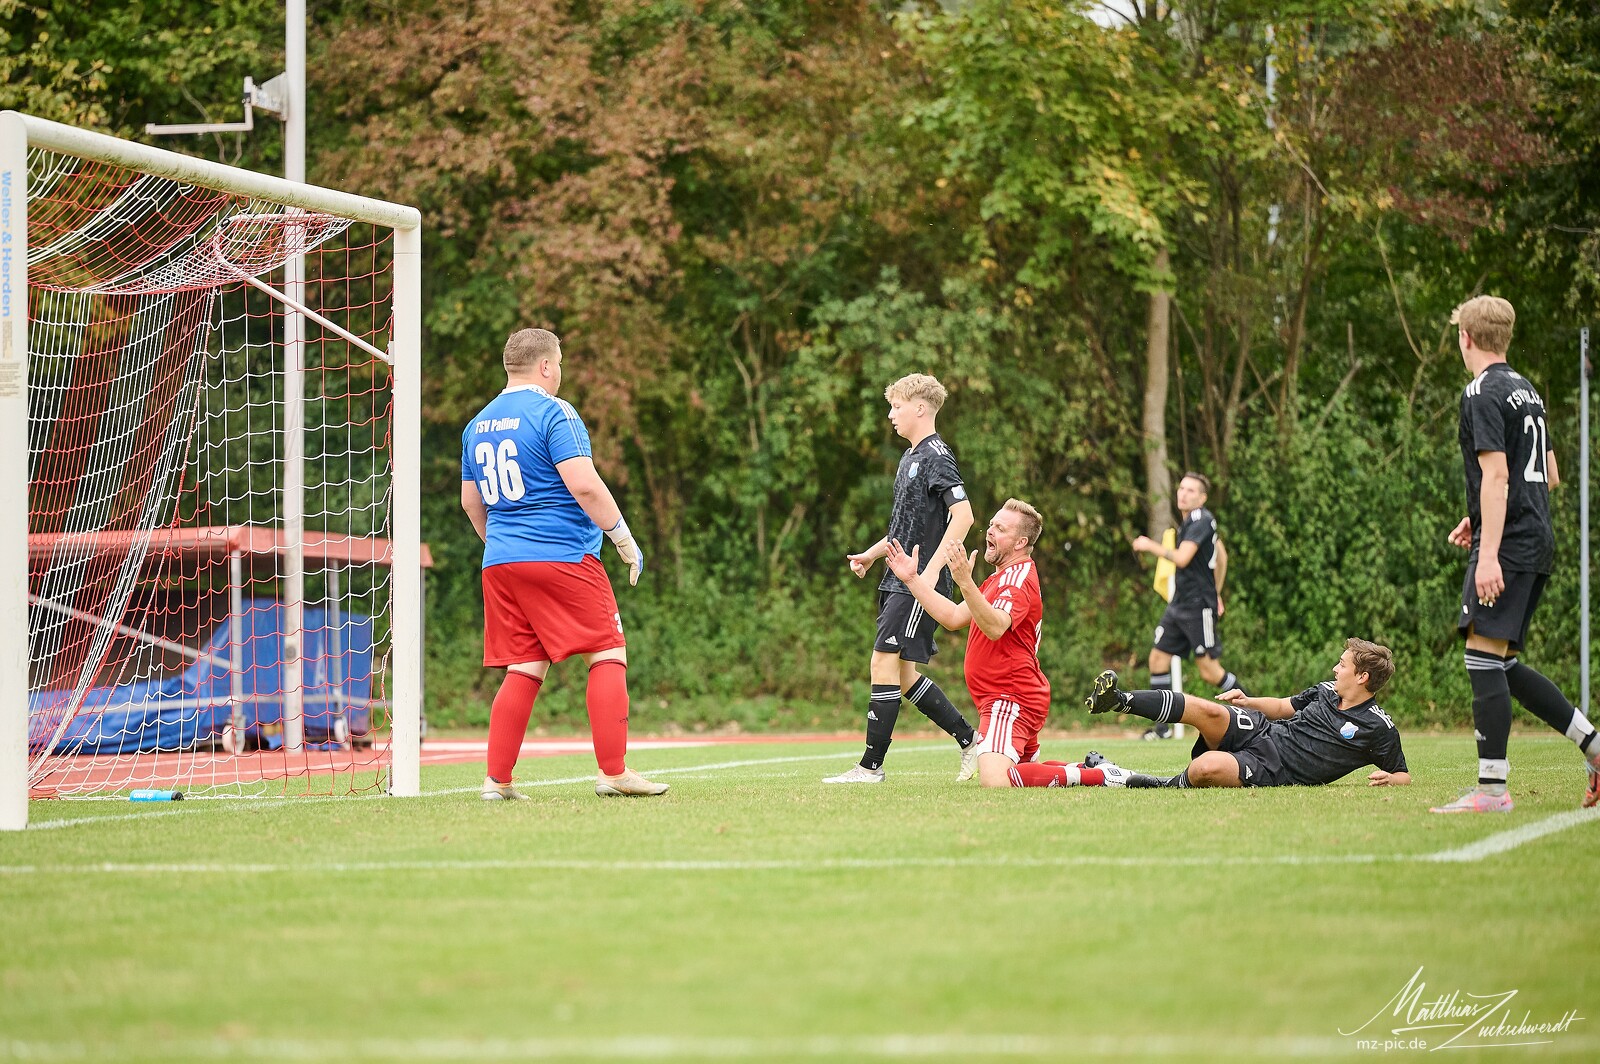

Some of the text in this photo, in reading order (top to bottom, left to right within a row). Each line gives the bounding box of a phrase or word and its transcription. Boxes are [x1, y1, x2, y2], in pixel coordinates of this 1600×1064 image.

[2, 248, 12, 317] Herden
[475, 419, 491, 434] TSV
[1524, 415, 1548, 483] 21
[475, 438, 526, 505] 36
